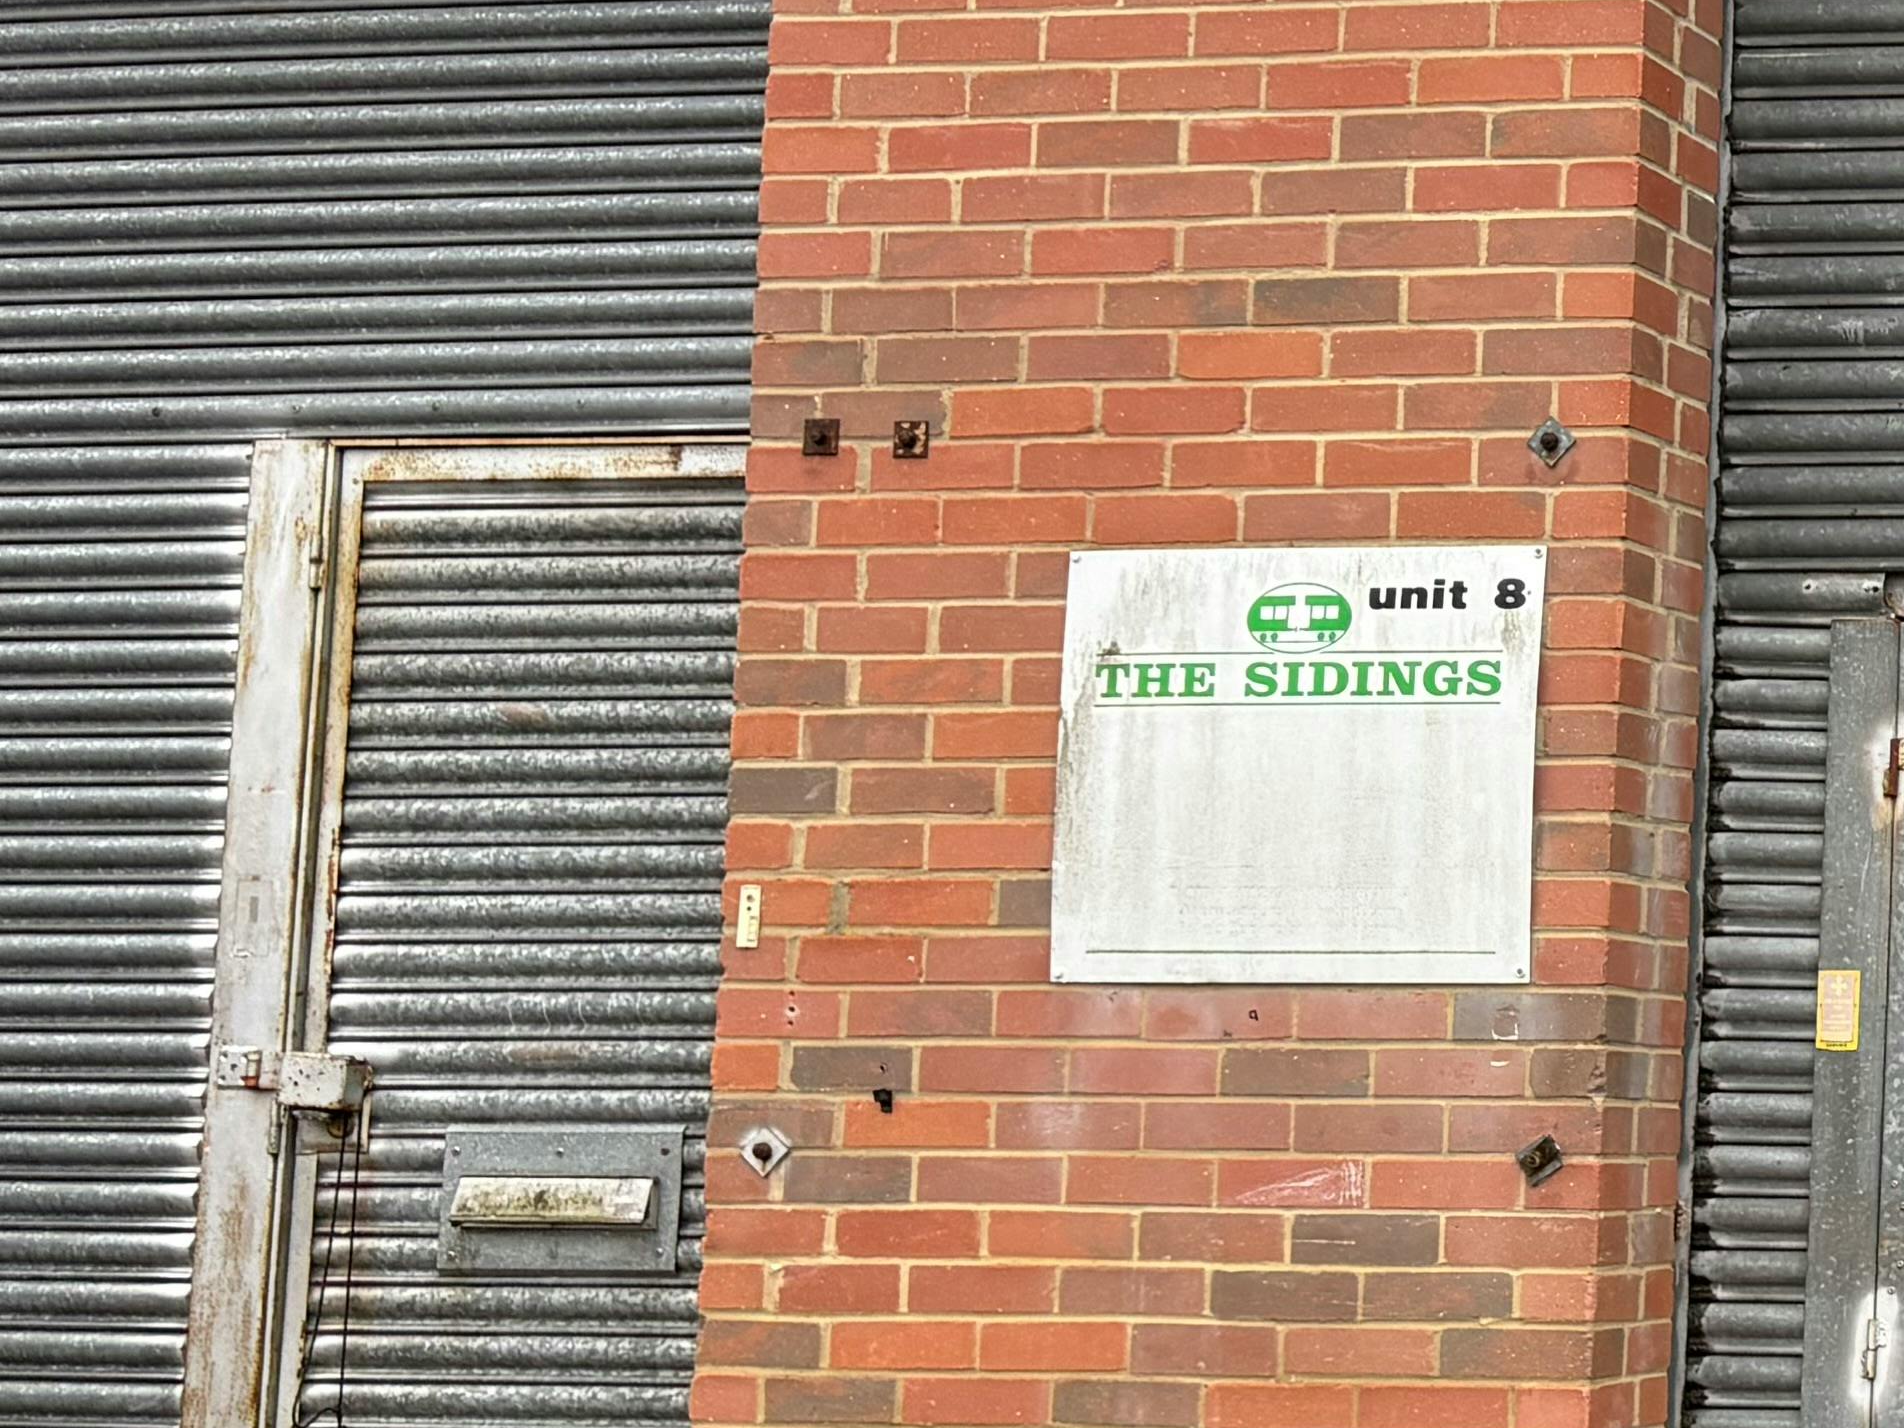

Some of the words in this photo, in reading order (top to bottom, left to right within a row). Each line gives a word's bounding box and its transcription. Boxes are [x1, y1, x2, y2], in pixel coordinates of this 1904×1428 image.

[1368, 579, 1467, 610] unit
[1494, 578, 1527, 610] 8
[1095, 662, 1216, 698] THE
[1244, 660, 1502, 697] SIDINGS
